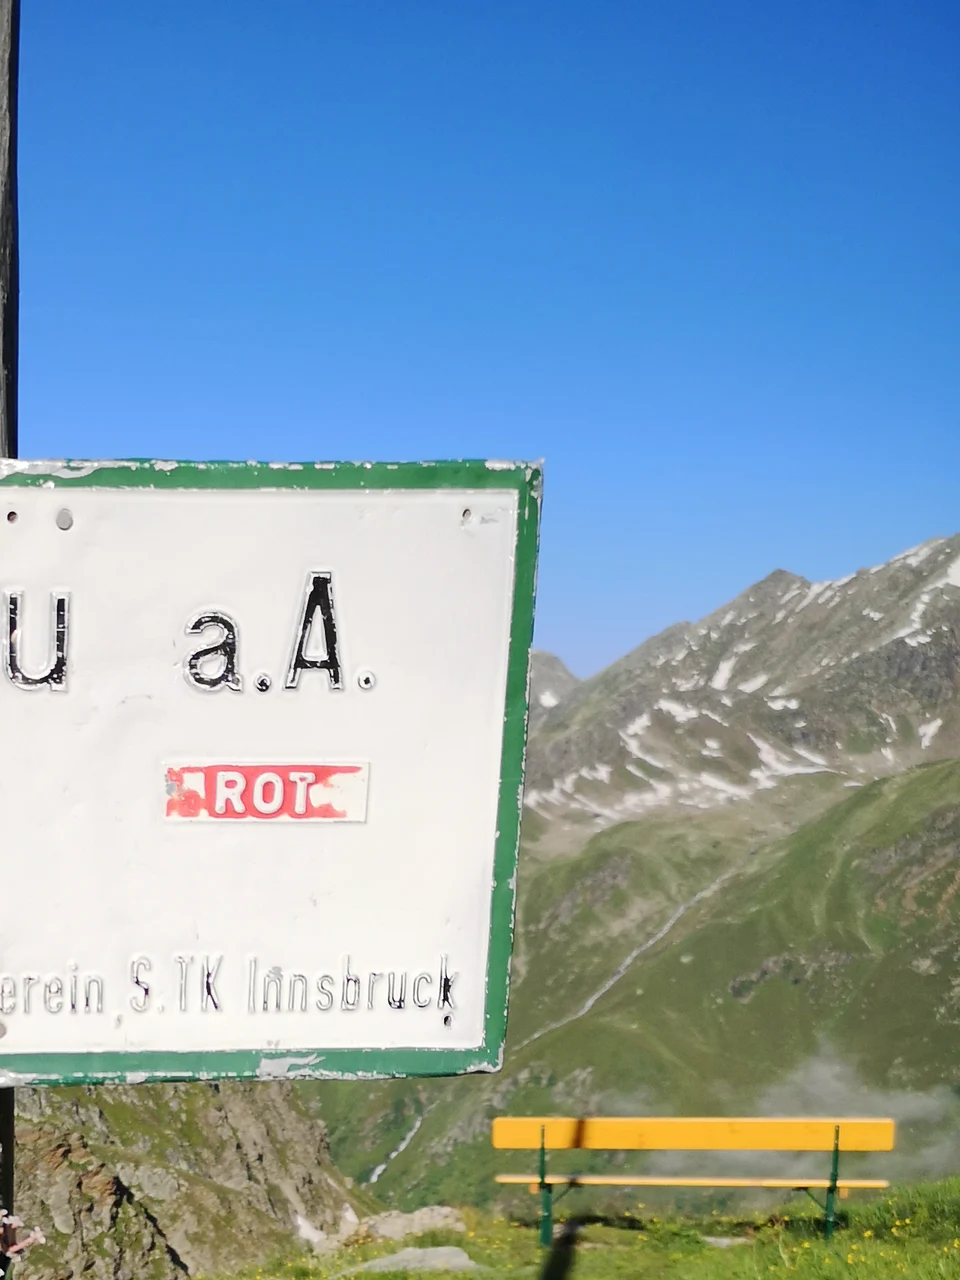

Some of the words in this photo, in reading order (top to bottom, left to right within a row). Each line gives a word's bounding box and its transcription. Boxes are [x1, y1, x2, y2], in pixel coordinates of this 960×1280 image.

[182, 569, 379, 693] a.A.
[214, 770, 317, 815] ROT
[247, 953, 460, 1014] Innsbruck
